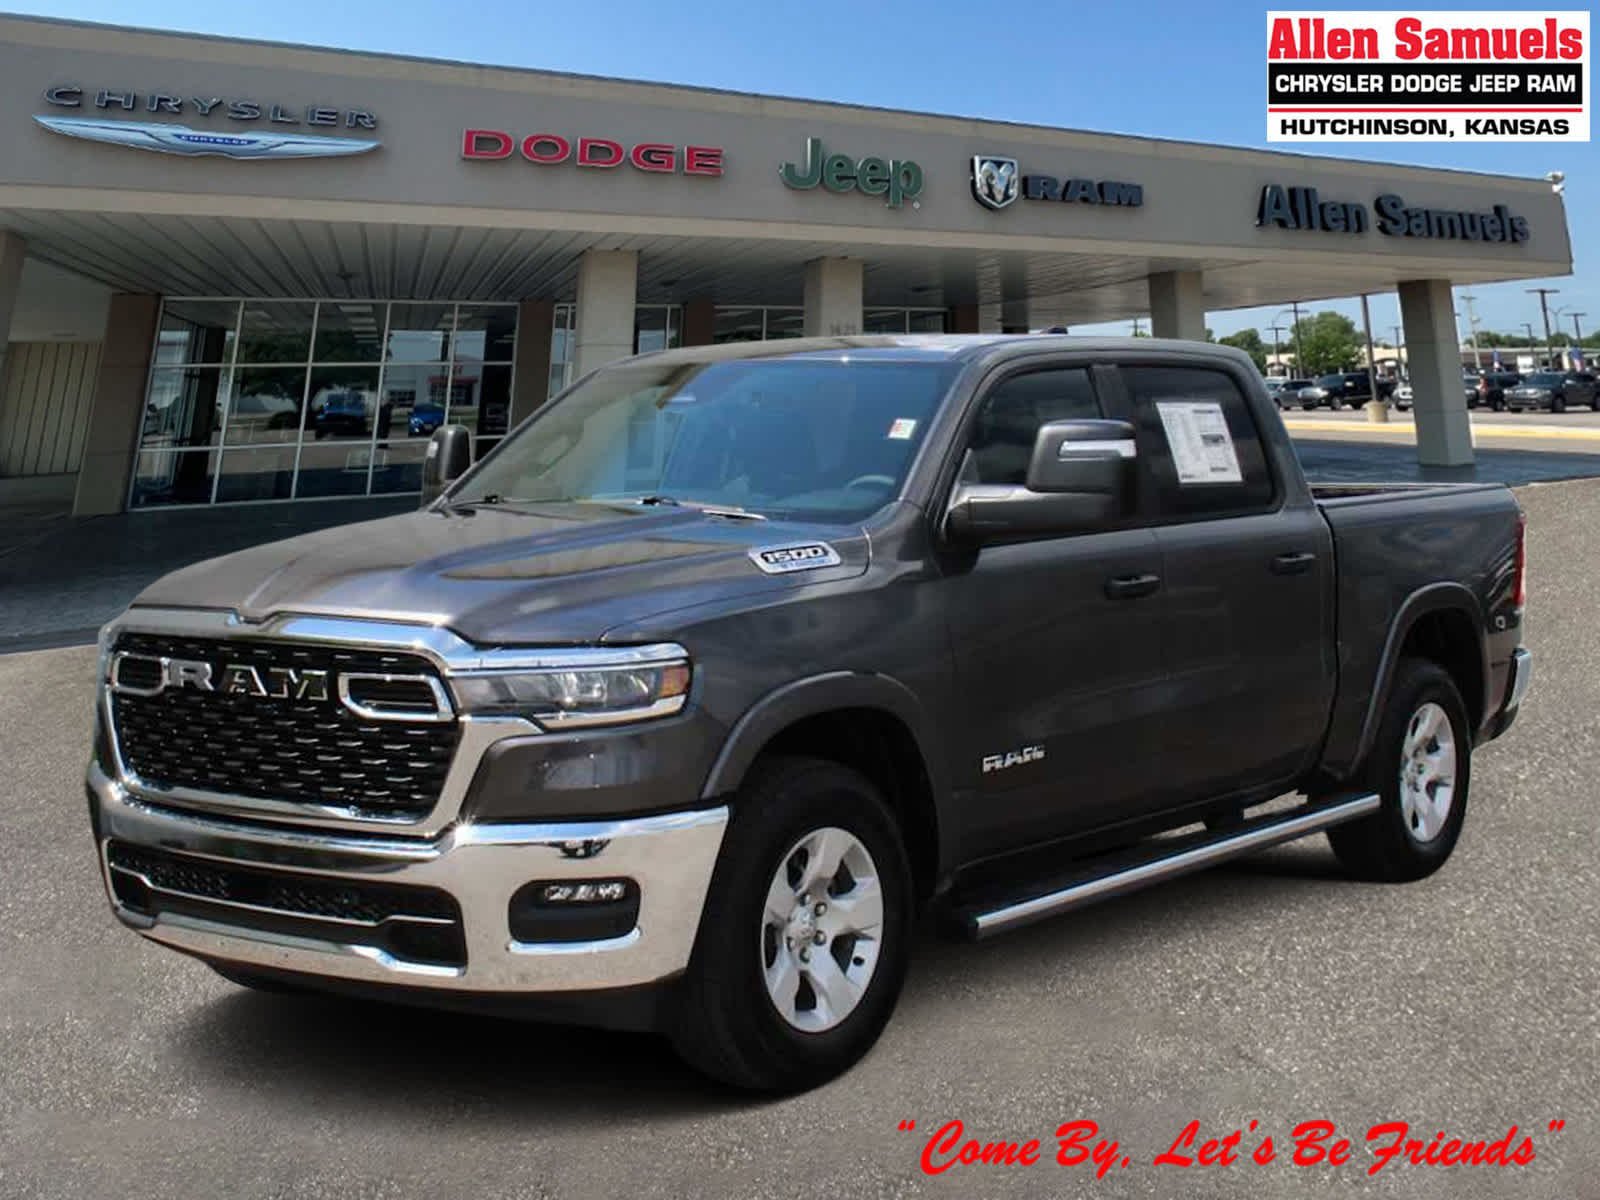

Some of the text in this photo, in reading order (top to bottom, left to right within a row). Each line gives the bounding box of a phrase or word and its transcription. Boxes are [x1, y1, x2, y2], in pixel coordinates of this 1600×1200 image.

[43, 85, 377, 128] CHRYSLER
[462, 128, 725, 177] DODGE
[779, 136, 923, 209] Jeep
[1022, 174, 1144, 207] RAM
[1256, 184, 1530, 243] Allen Samuels
[762, 546, 826, 564] 1500
[170, 658, 328, 701] RAM
